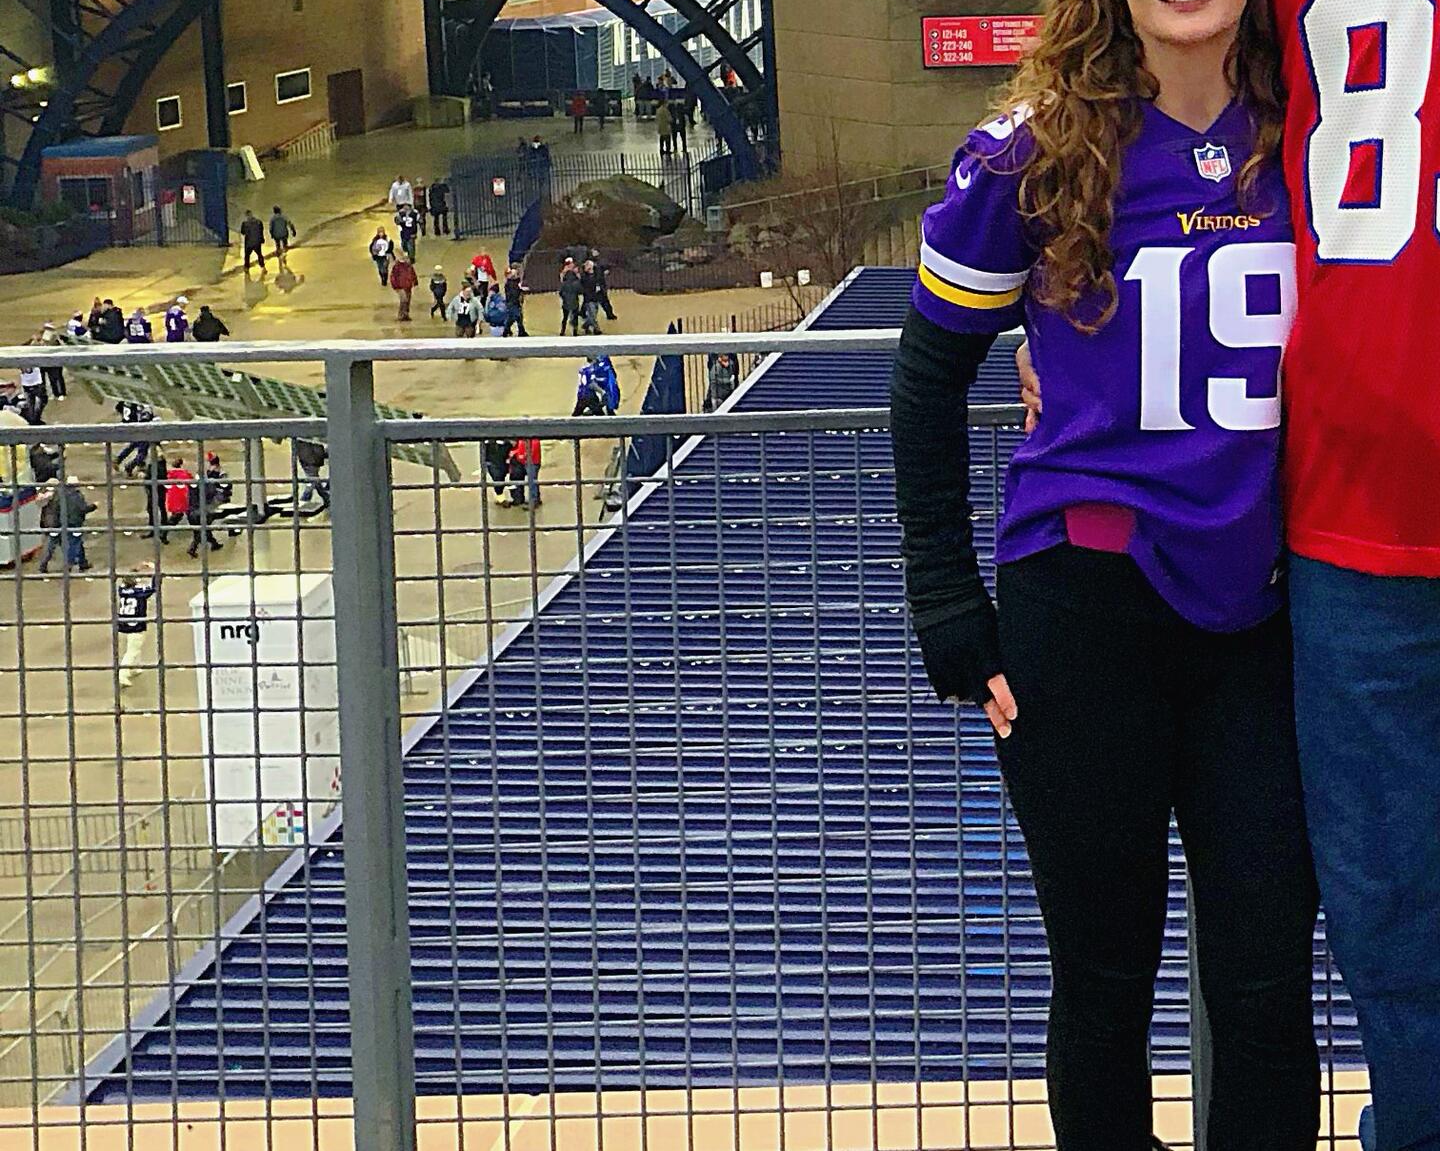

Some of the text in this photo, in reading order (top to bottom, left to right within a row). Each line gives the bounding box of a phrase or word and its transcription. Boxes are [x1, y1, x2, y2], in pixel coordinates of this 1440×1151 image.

[1201, 158, 1226, 174] NFL
[1124, 242, 1297, 430] 19
[120, 597, 138, 615] 12
[220, 623, 260, 644] nrg
